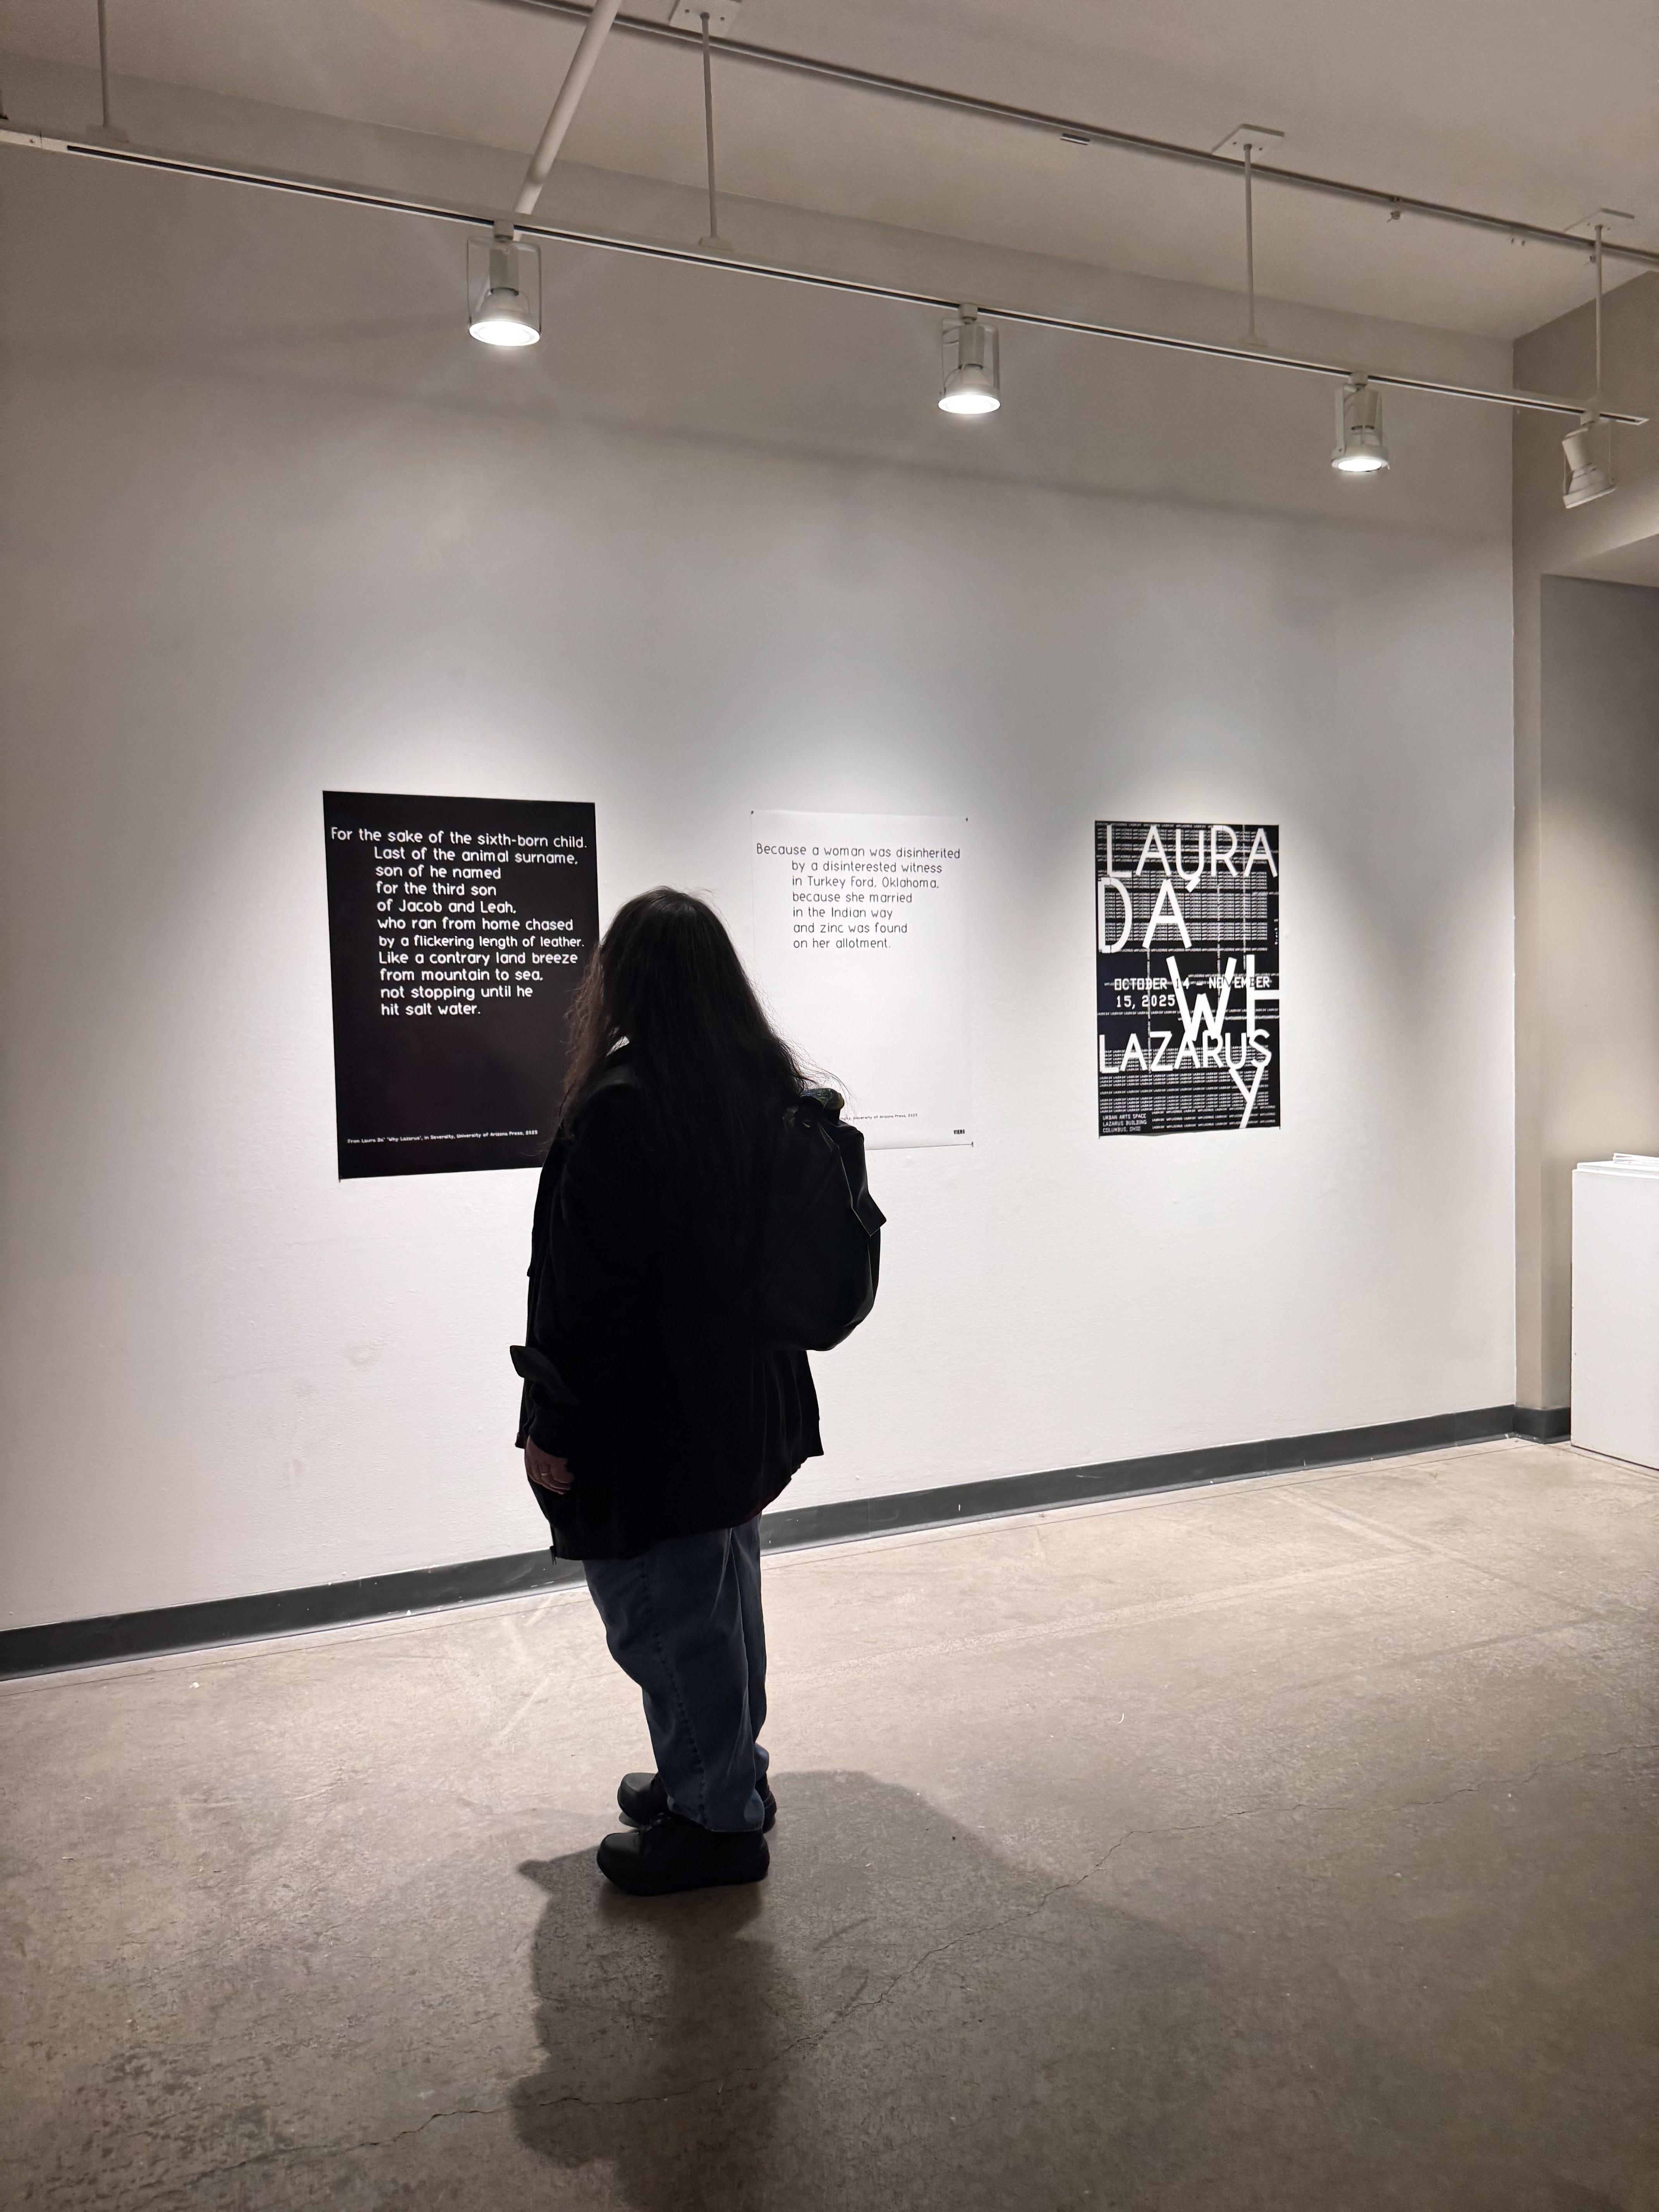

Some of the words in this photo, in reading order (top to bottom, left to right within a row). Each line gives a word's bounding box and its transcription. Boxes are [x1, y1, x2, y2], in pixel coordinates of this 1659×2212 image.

[331, 827, 353, 840] For
[359, 828, 382, 841] the
[388, 830, 423, 843] sake
[428, 830, 444, 843] of
[450, 831, 472, 845] the
[477, 833, 548, 847] sixth-born
[553, 835, 587, 848] child.
[374, 846, 405, 860] Last
[411, 847, 428, 860] of
[433, 848, 455, 861] the
[462, 850, 508, 862] animal
[757, 843, 806, 855] Because
[812, 847, 819, 855] a
[824, 848, 864, 856] woman
[869, 848, 891, 857] was
[896, 847, 960, 859] disinherited
[1106, 824, 1278, 881] LAURA
[375, 866, 403, 877] son
[408, 864, 424, 877] of
[430, 865, 447, 878] he
[452, 867, 501, 879] named
[792, 860, 805, 872] by
[811, 862, 817, 871] a
[823, 861, 896, 872] disinterested
[902, 863, 942, 873] witness
[376, 881, 398, 894] for
[404, 881, 427, 895] the
[432, 882, 465, 896] third
[471, 886, 496, 896] son
[792, 876, 802, 886] in
[807, 876, 845, 889] Turkey
[793, 892, 840, 902] because
[846, 892, 864, 902] she
[869, 893, 912, 903] married
[377, 898, 393, 912] of
[398, 899, 442, 912] Jacob
[448, 900, 475, 913] and
[793, 907, 803, 917] in
[808, 907, 825, 917] the
[831, 907, 866, 917] Indian
[871, 910, 893, 920] way
[377, 916, 406, 929] who
[412, 919, 436, 929] ran
[442, 916, 476, 930] from
[482, 917, 520, 930] home
[526, 918, 573, 931] chased
[793, 923, 814, 933] and
[820, 922, 843, 933] zinc
[848, 925, 870, 933] was
[875, 922, 907, 933] found
[379, 936, 395, 948] by
[400, 937, 409, 946] a
[414, 934, 474, 950] flickering
[479, 936, 518, 950] length
[522, 935, 536, 947] of
[540, 936, 584, 947] leather.
[793, 940, 807, 948] on
[813, 938, 830, 948] her
[379, 951, 409, 964] Like
[415, 953, 424, 964] a
[429, 951, 490, 966] contrary
[496, 951, 526, 964] land
[532, 952, 578, 964] breeze
[380, 968, 414, 981] from
[421, 968, 490, 981] mountain
[495, 968, 509, 981] to
[1114, 977, 1167, 991] OCTOBER
[1209, 976, 1270, 989] NOVEMBER
[381, 986, 405, 998] not
[410, 985, 475, 1001] stopping
[481, 985, 511, 998] until
[517, 985, 533, 997] he
[381, 1003, 399, 1016] hit
[405, 1003, 432, 1016] salt
[438, 1002, 481, 1015] water.
[1116, 995, 1136, 1010] 15,
[1142, 994, 1175, 1008] 2025
[1099, 1029, 1272, 1073] LAZARUS
